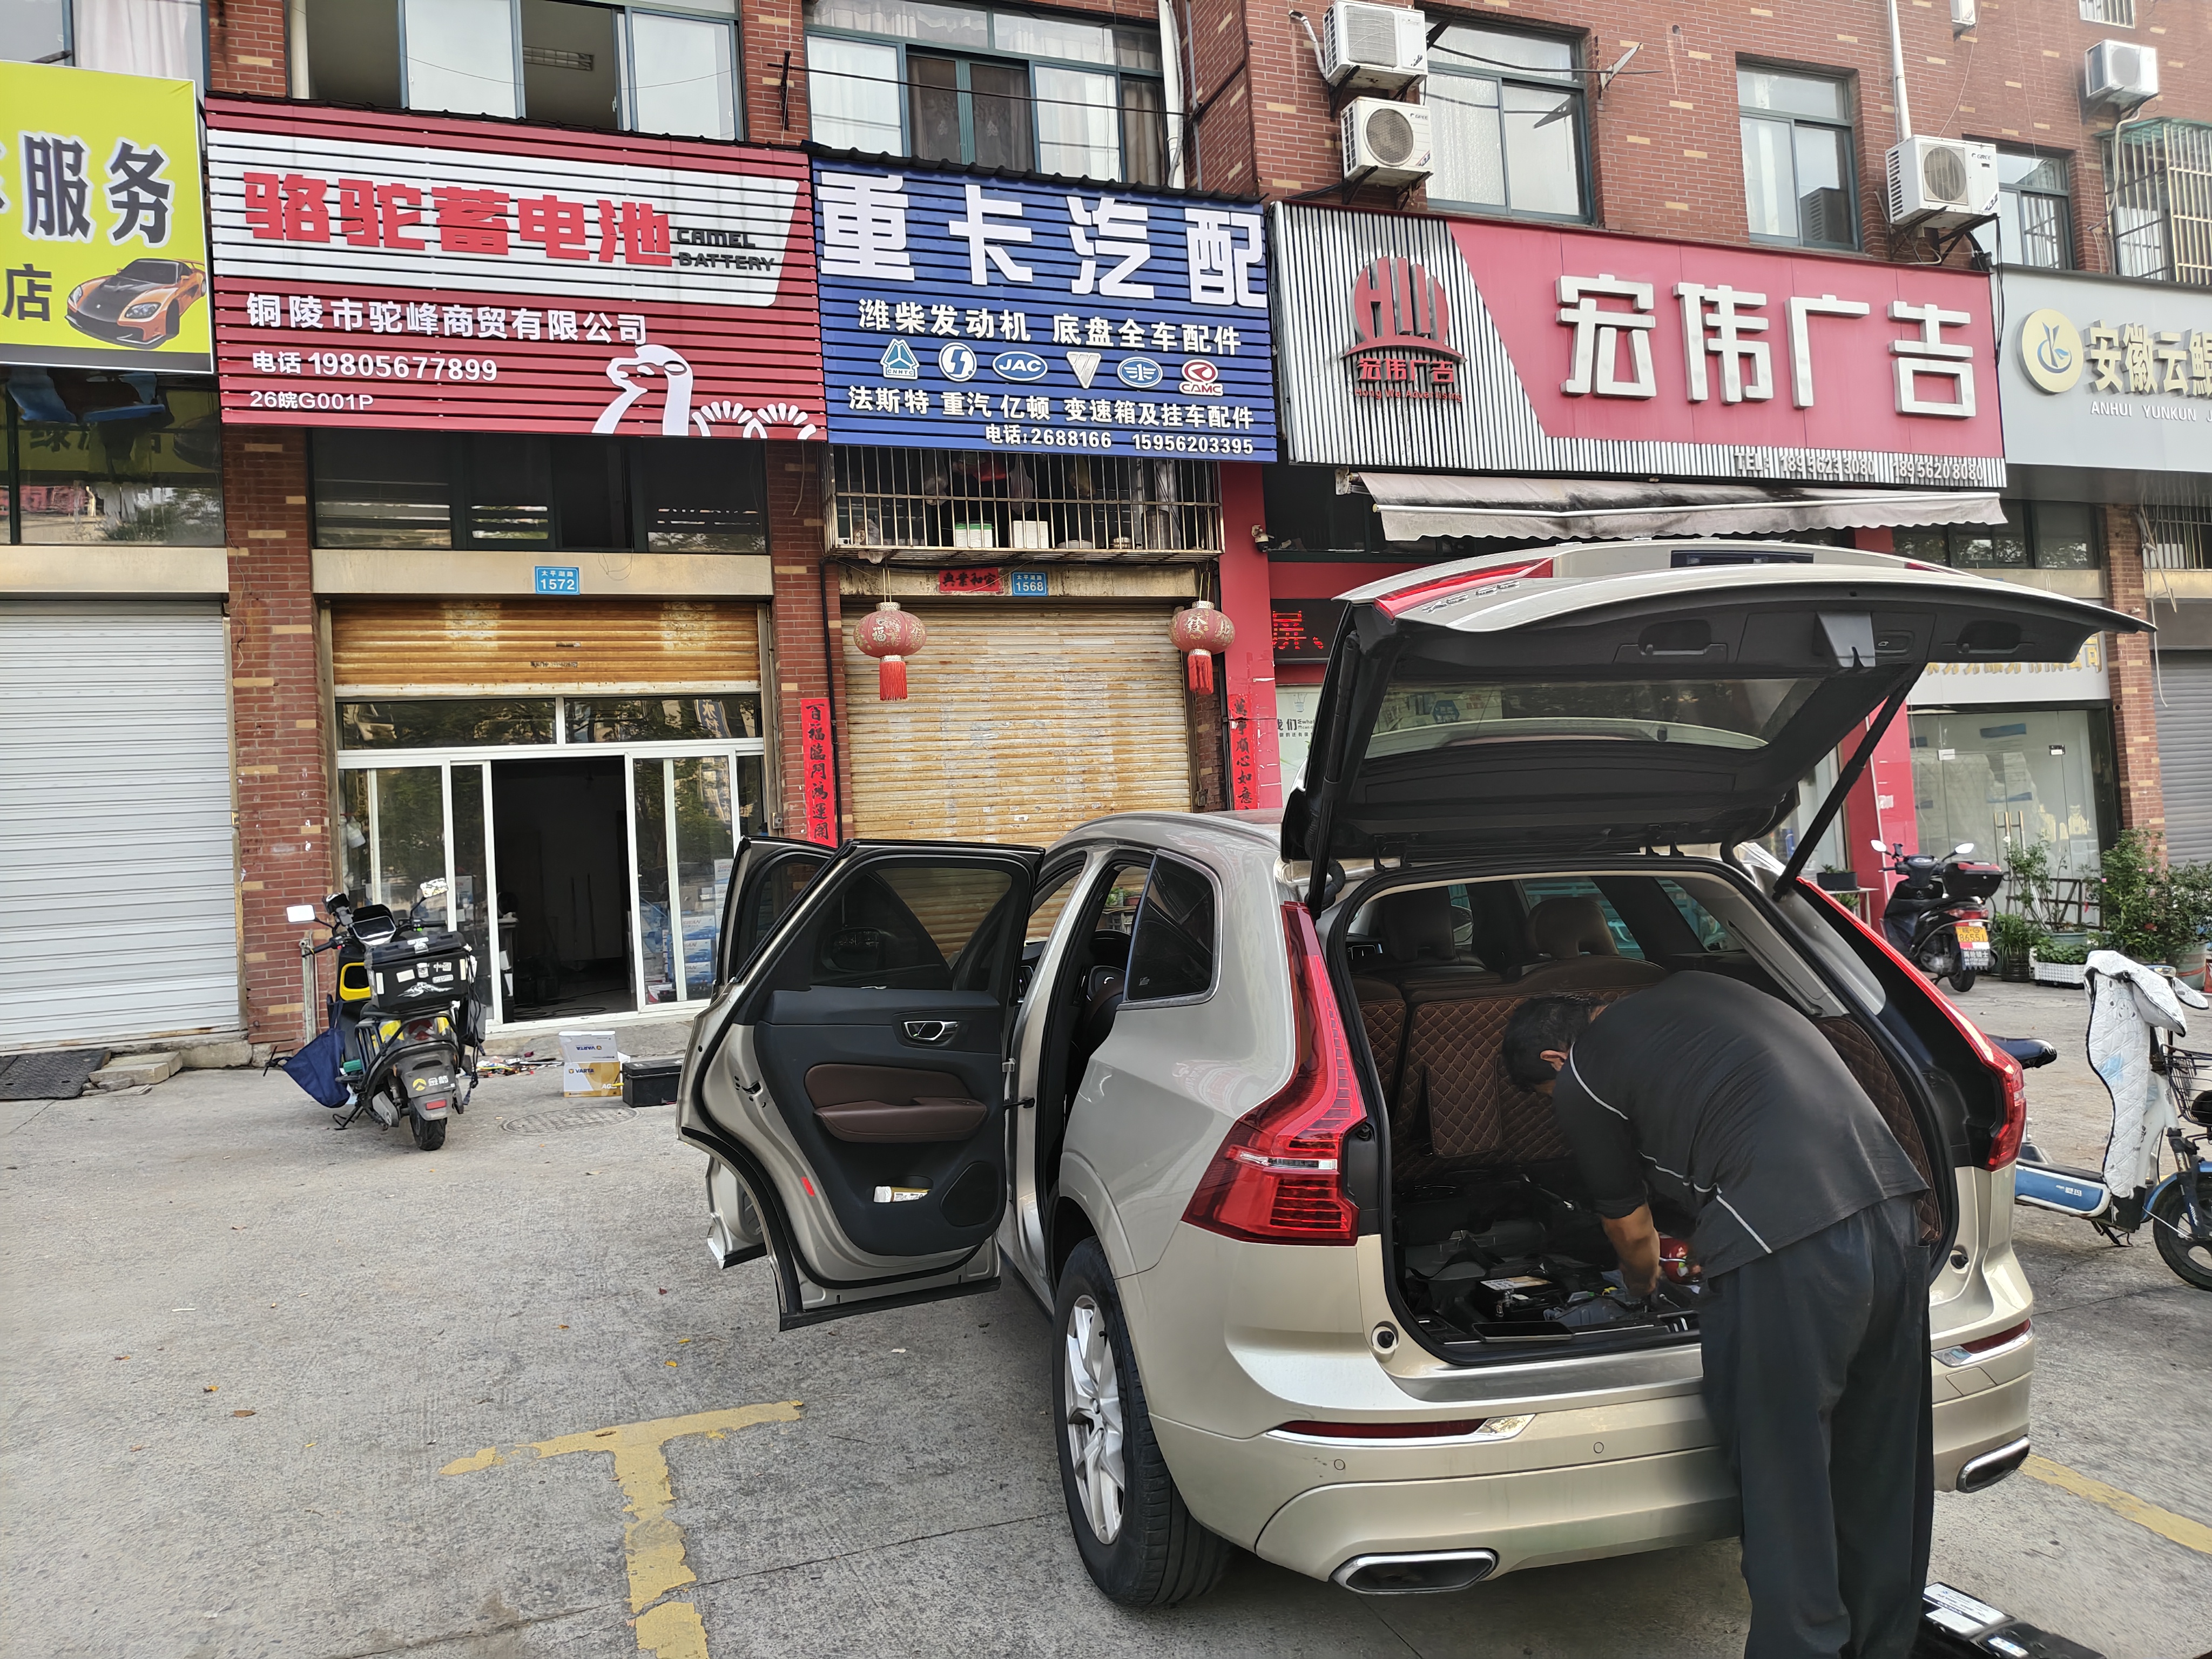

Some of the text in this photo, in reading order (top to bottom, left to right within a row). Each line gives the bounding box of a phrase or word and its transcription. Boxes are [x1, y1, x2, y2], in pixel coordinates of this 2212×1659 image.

[0, 133, 171, 244] 服务
[244, 172, 672, 266] 骆驼蓄电池
[677, 229, 756, 248] CAMEL
[817, 172, 1268, 308] 重卡汽配
[679, 252, 774, 272] BATTERY
[2, 264, 52, 321] 店
[246, 292, 647, 345] 铜陵市驼峰商贸有限公司
[858, 299, 1242, 356] 潍柴发动机 底盘全车配件
[1555, 273, 1977, 419] 宏伟广告
[252, 350, 497, 381] 电话 19805677899
[1002, 359, 1042, 372] JAC
[1181, 383, 1222, 394] CAMC
[1354, 388, 1382, 400] Hong
[249, 390, 375, 410] 26皖G001P
[848, 385, 1255, 430] 法斯特 重汽 亿顿 变速箱及挂车配件
[2090, 401, 2197, 421] ANHUI YUNKUN
[1132, 434, 1253, 456] 15956203395
[540, 578, 575, 590] 1572
[1016, 582, 1044, 591] 1568
[1959, 933, 1985, 942] 86551
